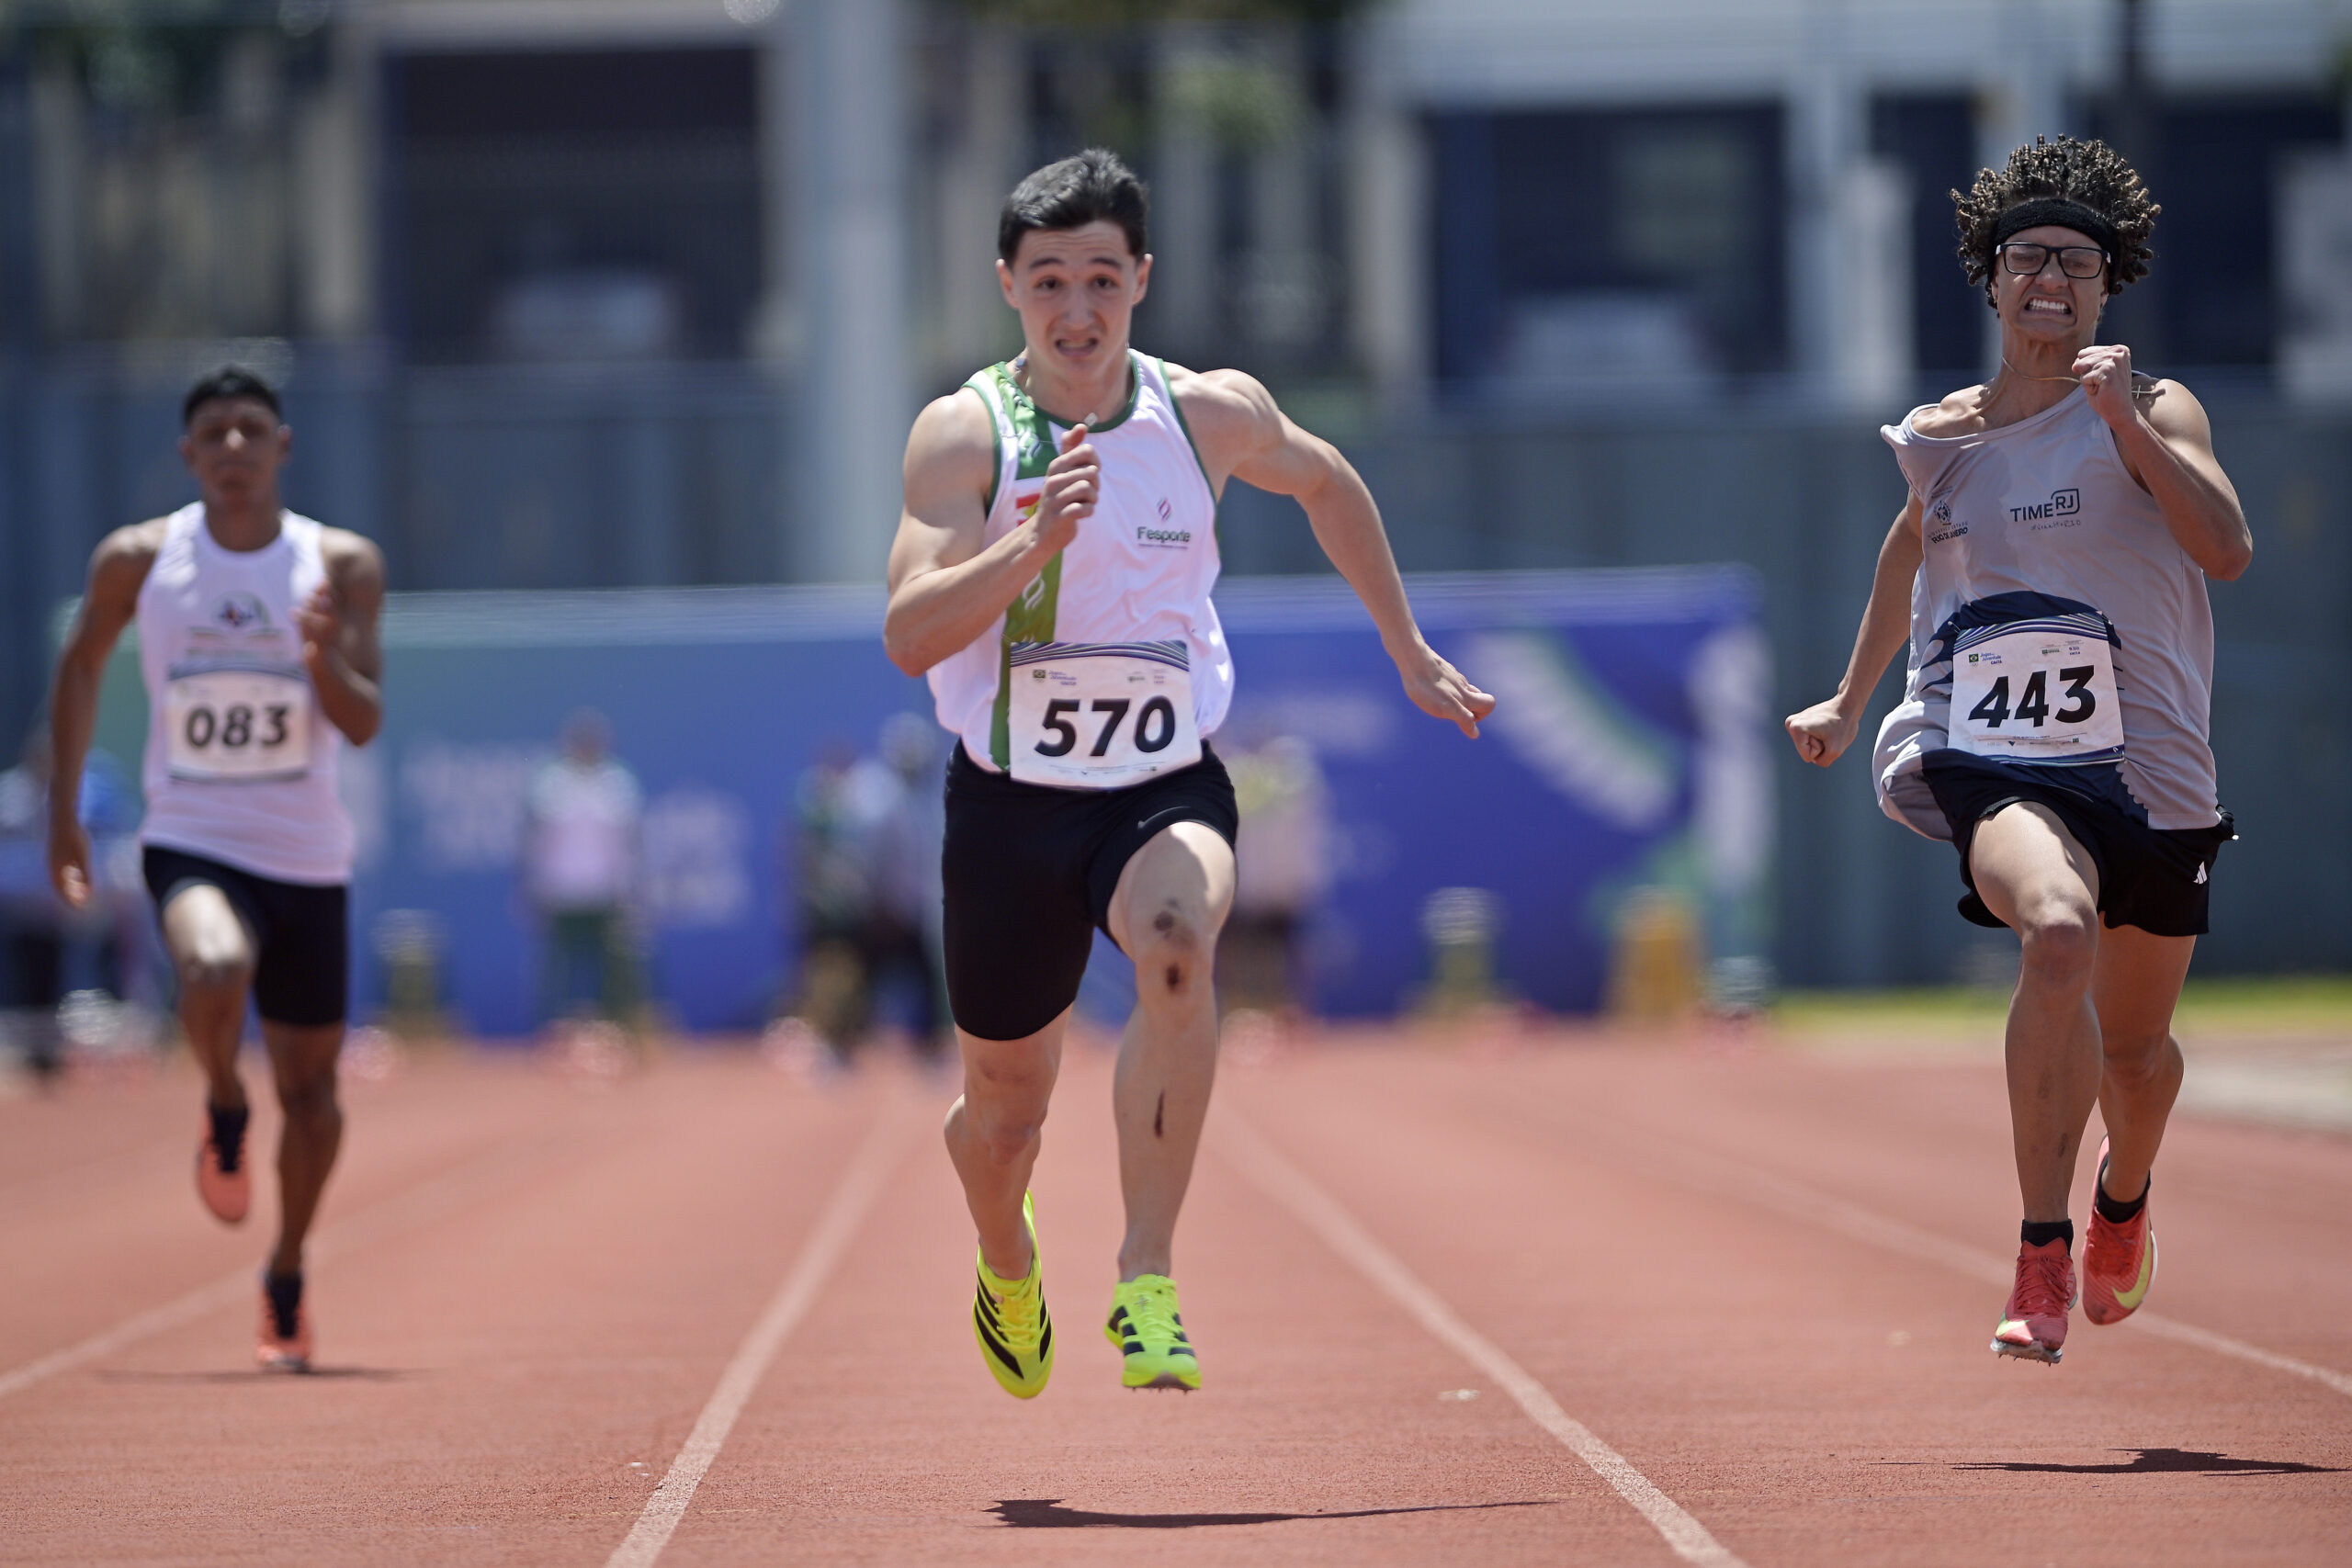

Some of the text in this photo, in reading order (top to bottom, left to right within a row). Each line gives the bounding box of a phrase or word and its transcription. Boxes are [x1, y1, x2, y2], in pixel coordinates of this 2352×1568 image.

[1136, 525, 1191, 544] Fesporte
[1967, 664, 2097, 728] 443
[186, 703, 290, 749] 083
[1034, 694, 1176, 757] 570
